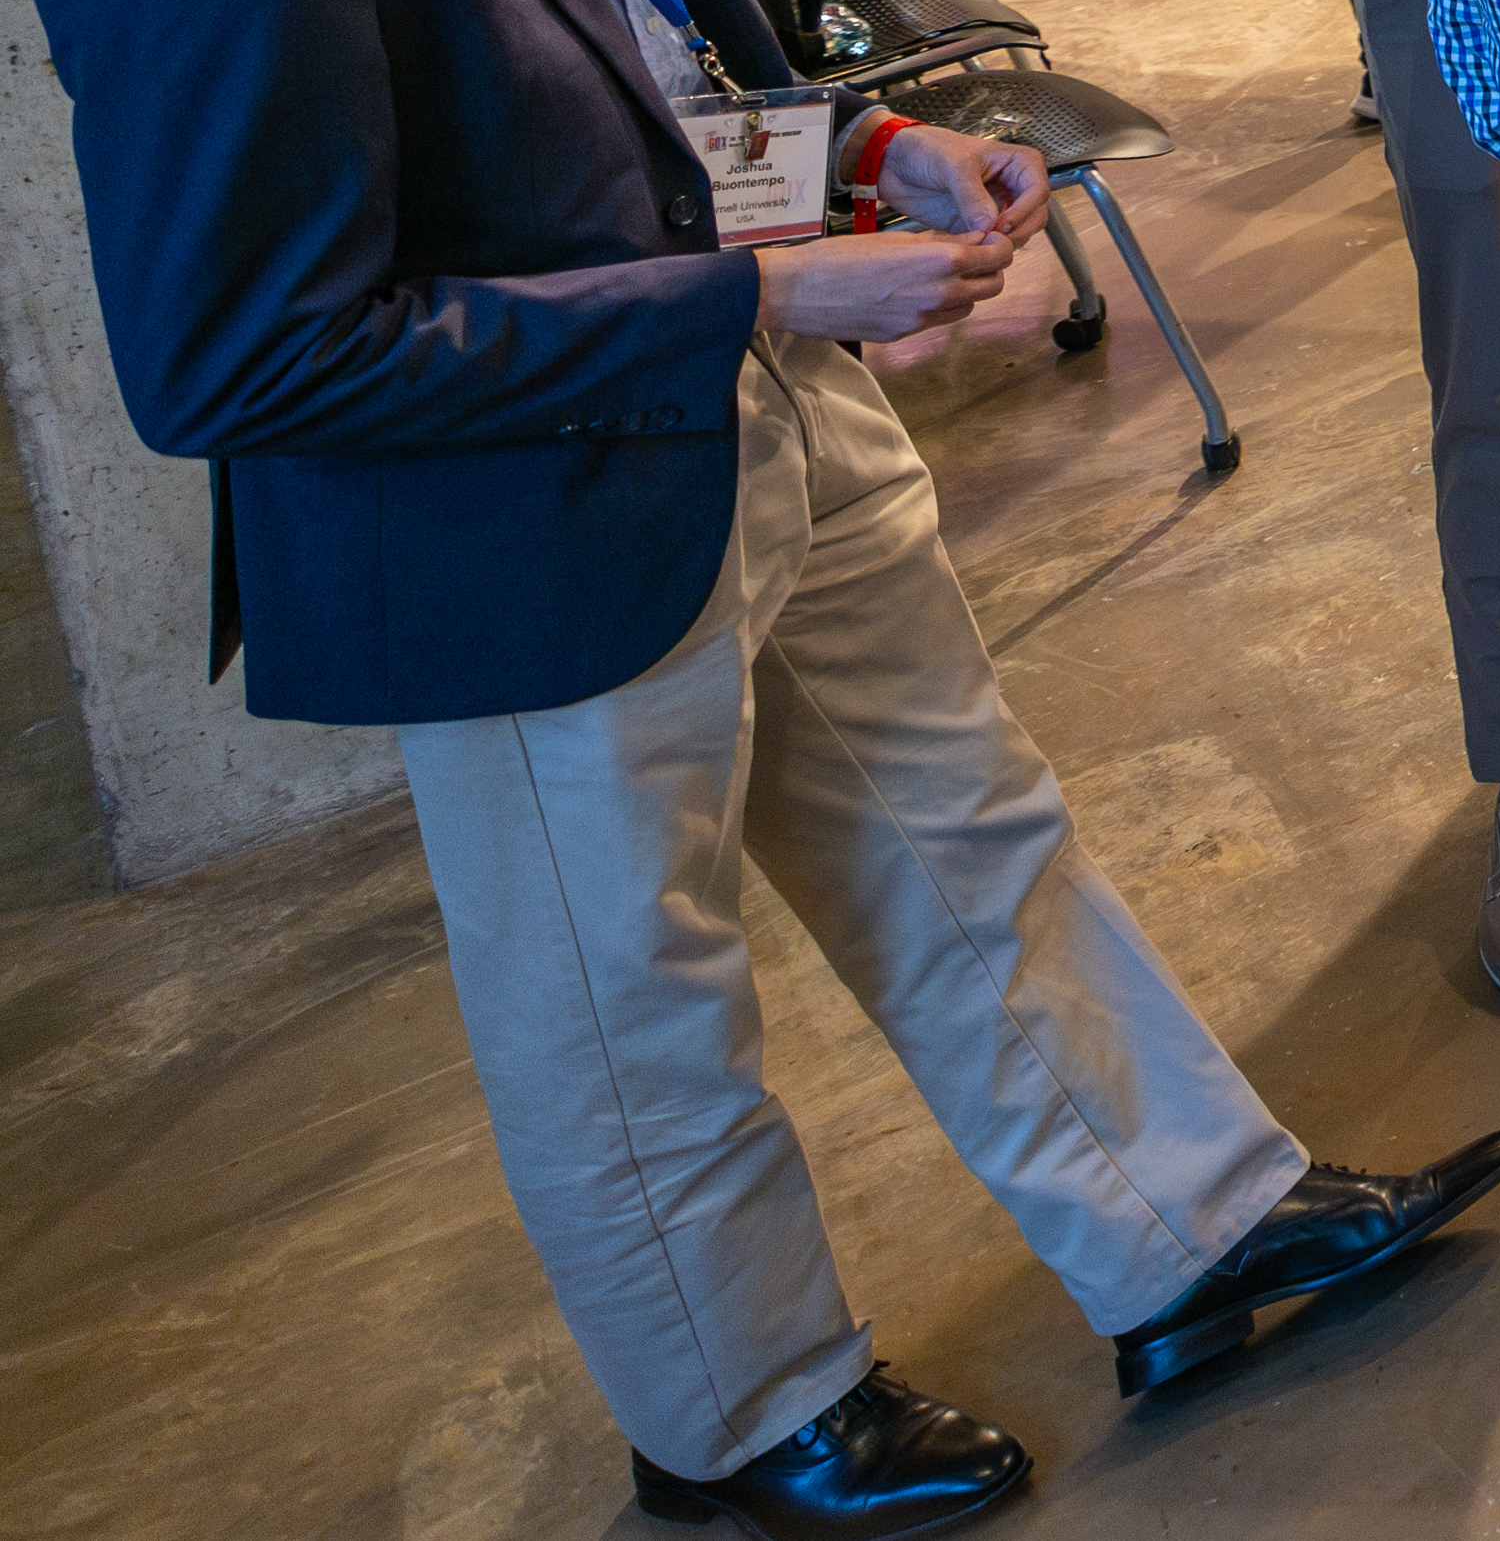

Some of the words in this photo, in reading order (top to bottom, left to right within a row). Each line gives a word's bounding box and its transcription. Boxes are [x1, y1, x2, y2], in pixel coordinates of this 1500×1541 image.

[707, 135, 728, 151] GOX
[726, 162, 773, 175] Joshua
[712, 176, 785, 192] Buontempo
[716, 203, 737, 214] rnell
[740, 196, 791, 211] University
[736, 214, 756, 224] USA
